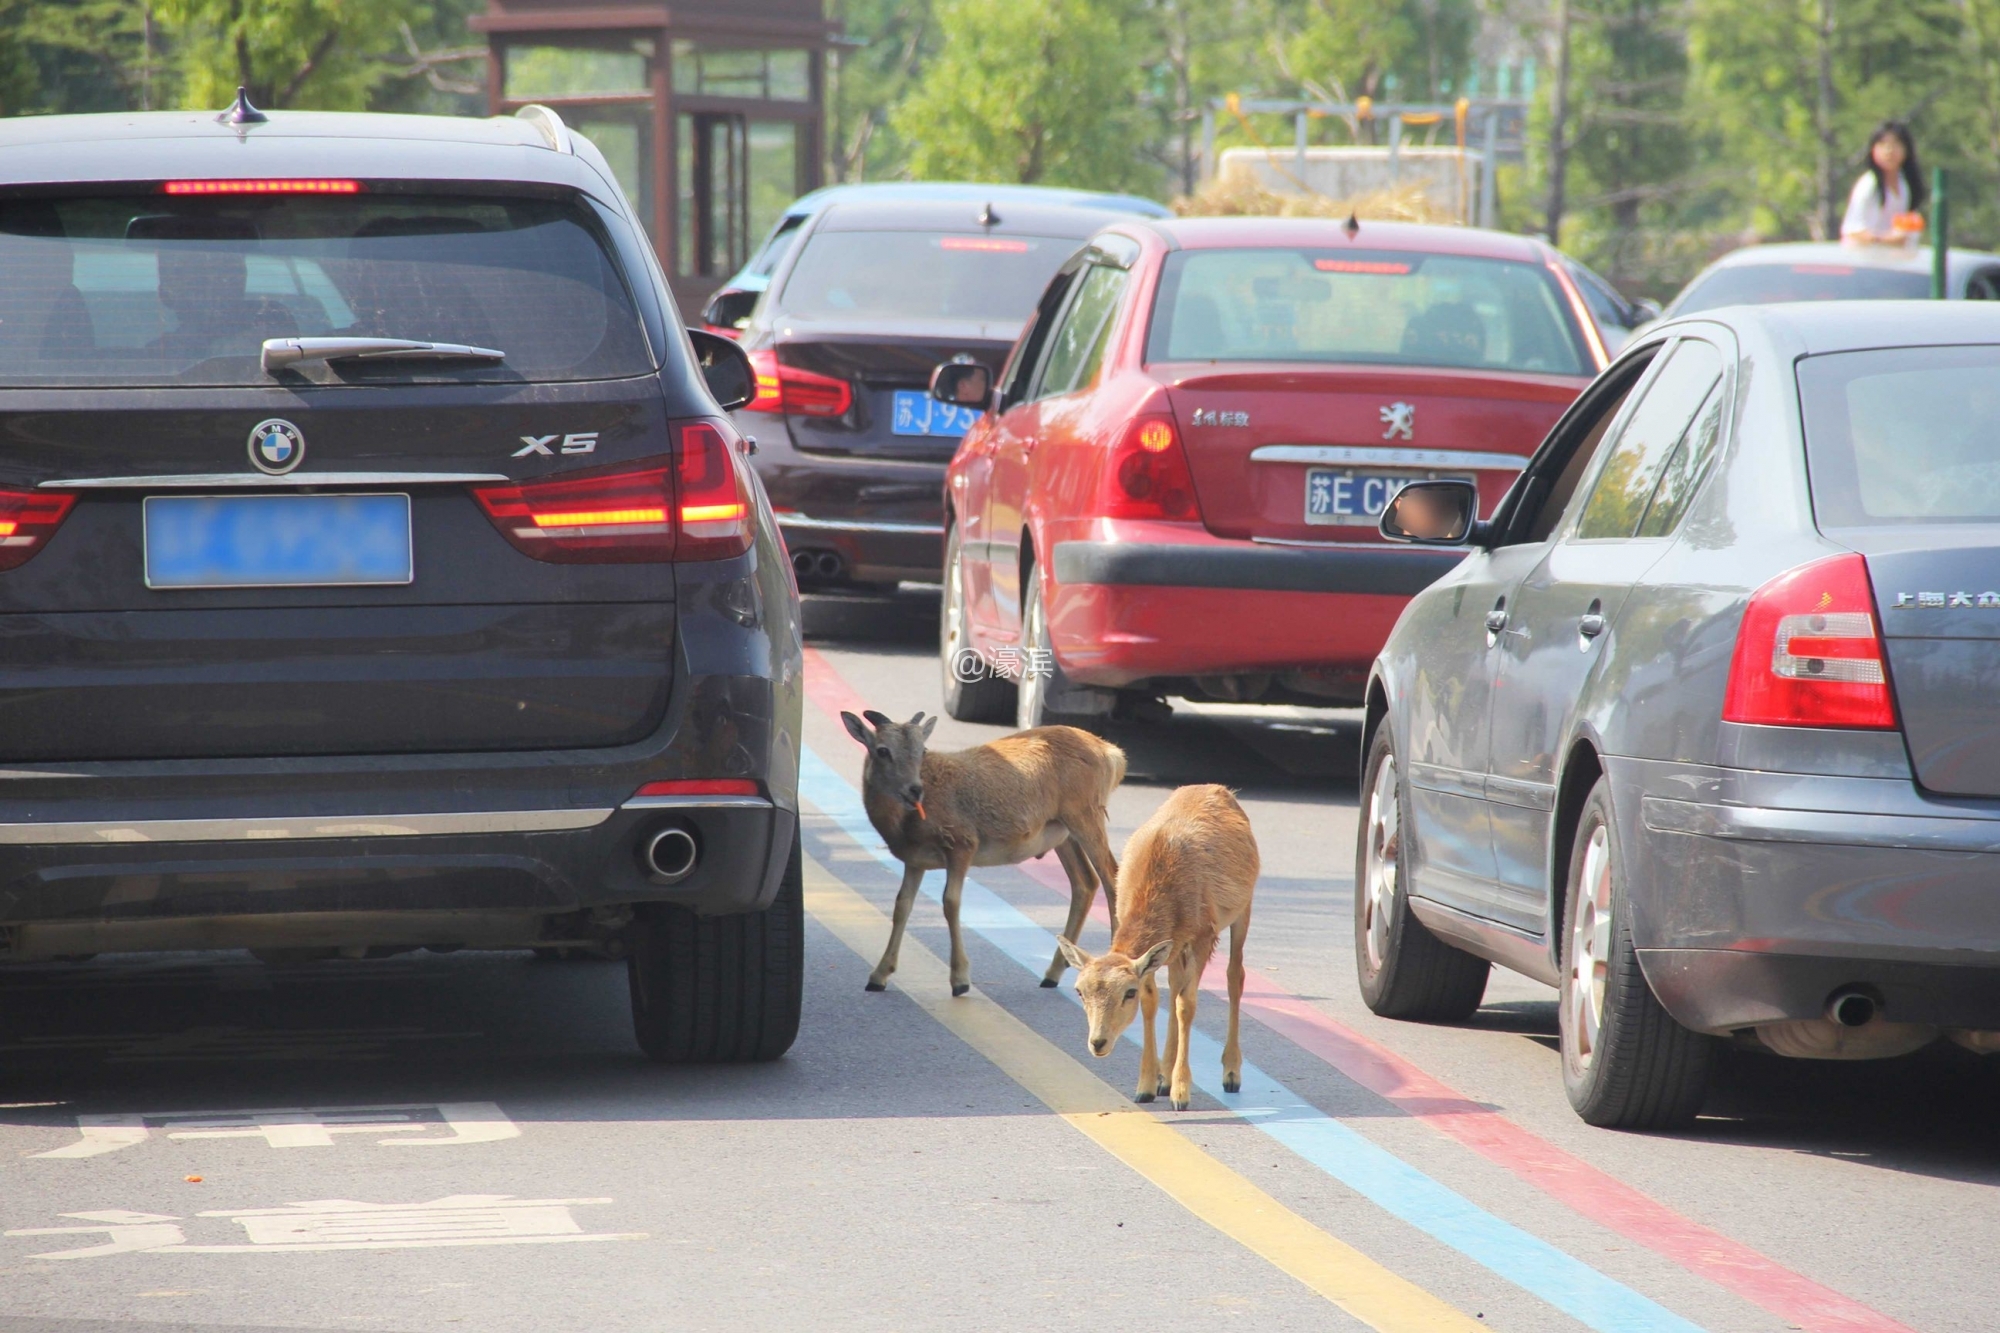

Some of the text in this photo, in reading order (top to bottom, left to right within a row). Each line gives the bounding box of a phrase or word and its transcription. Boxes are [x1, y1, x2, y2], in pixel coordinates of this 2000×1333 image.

[256, 424, 298, 441] BMW
[510, 432, 600, 458] X5
[1889, 590, 2000, 609] 上海大众
